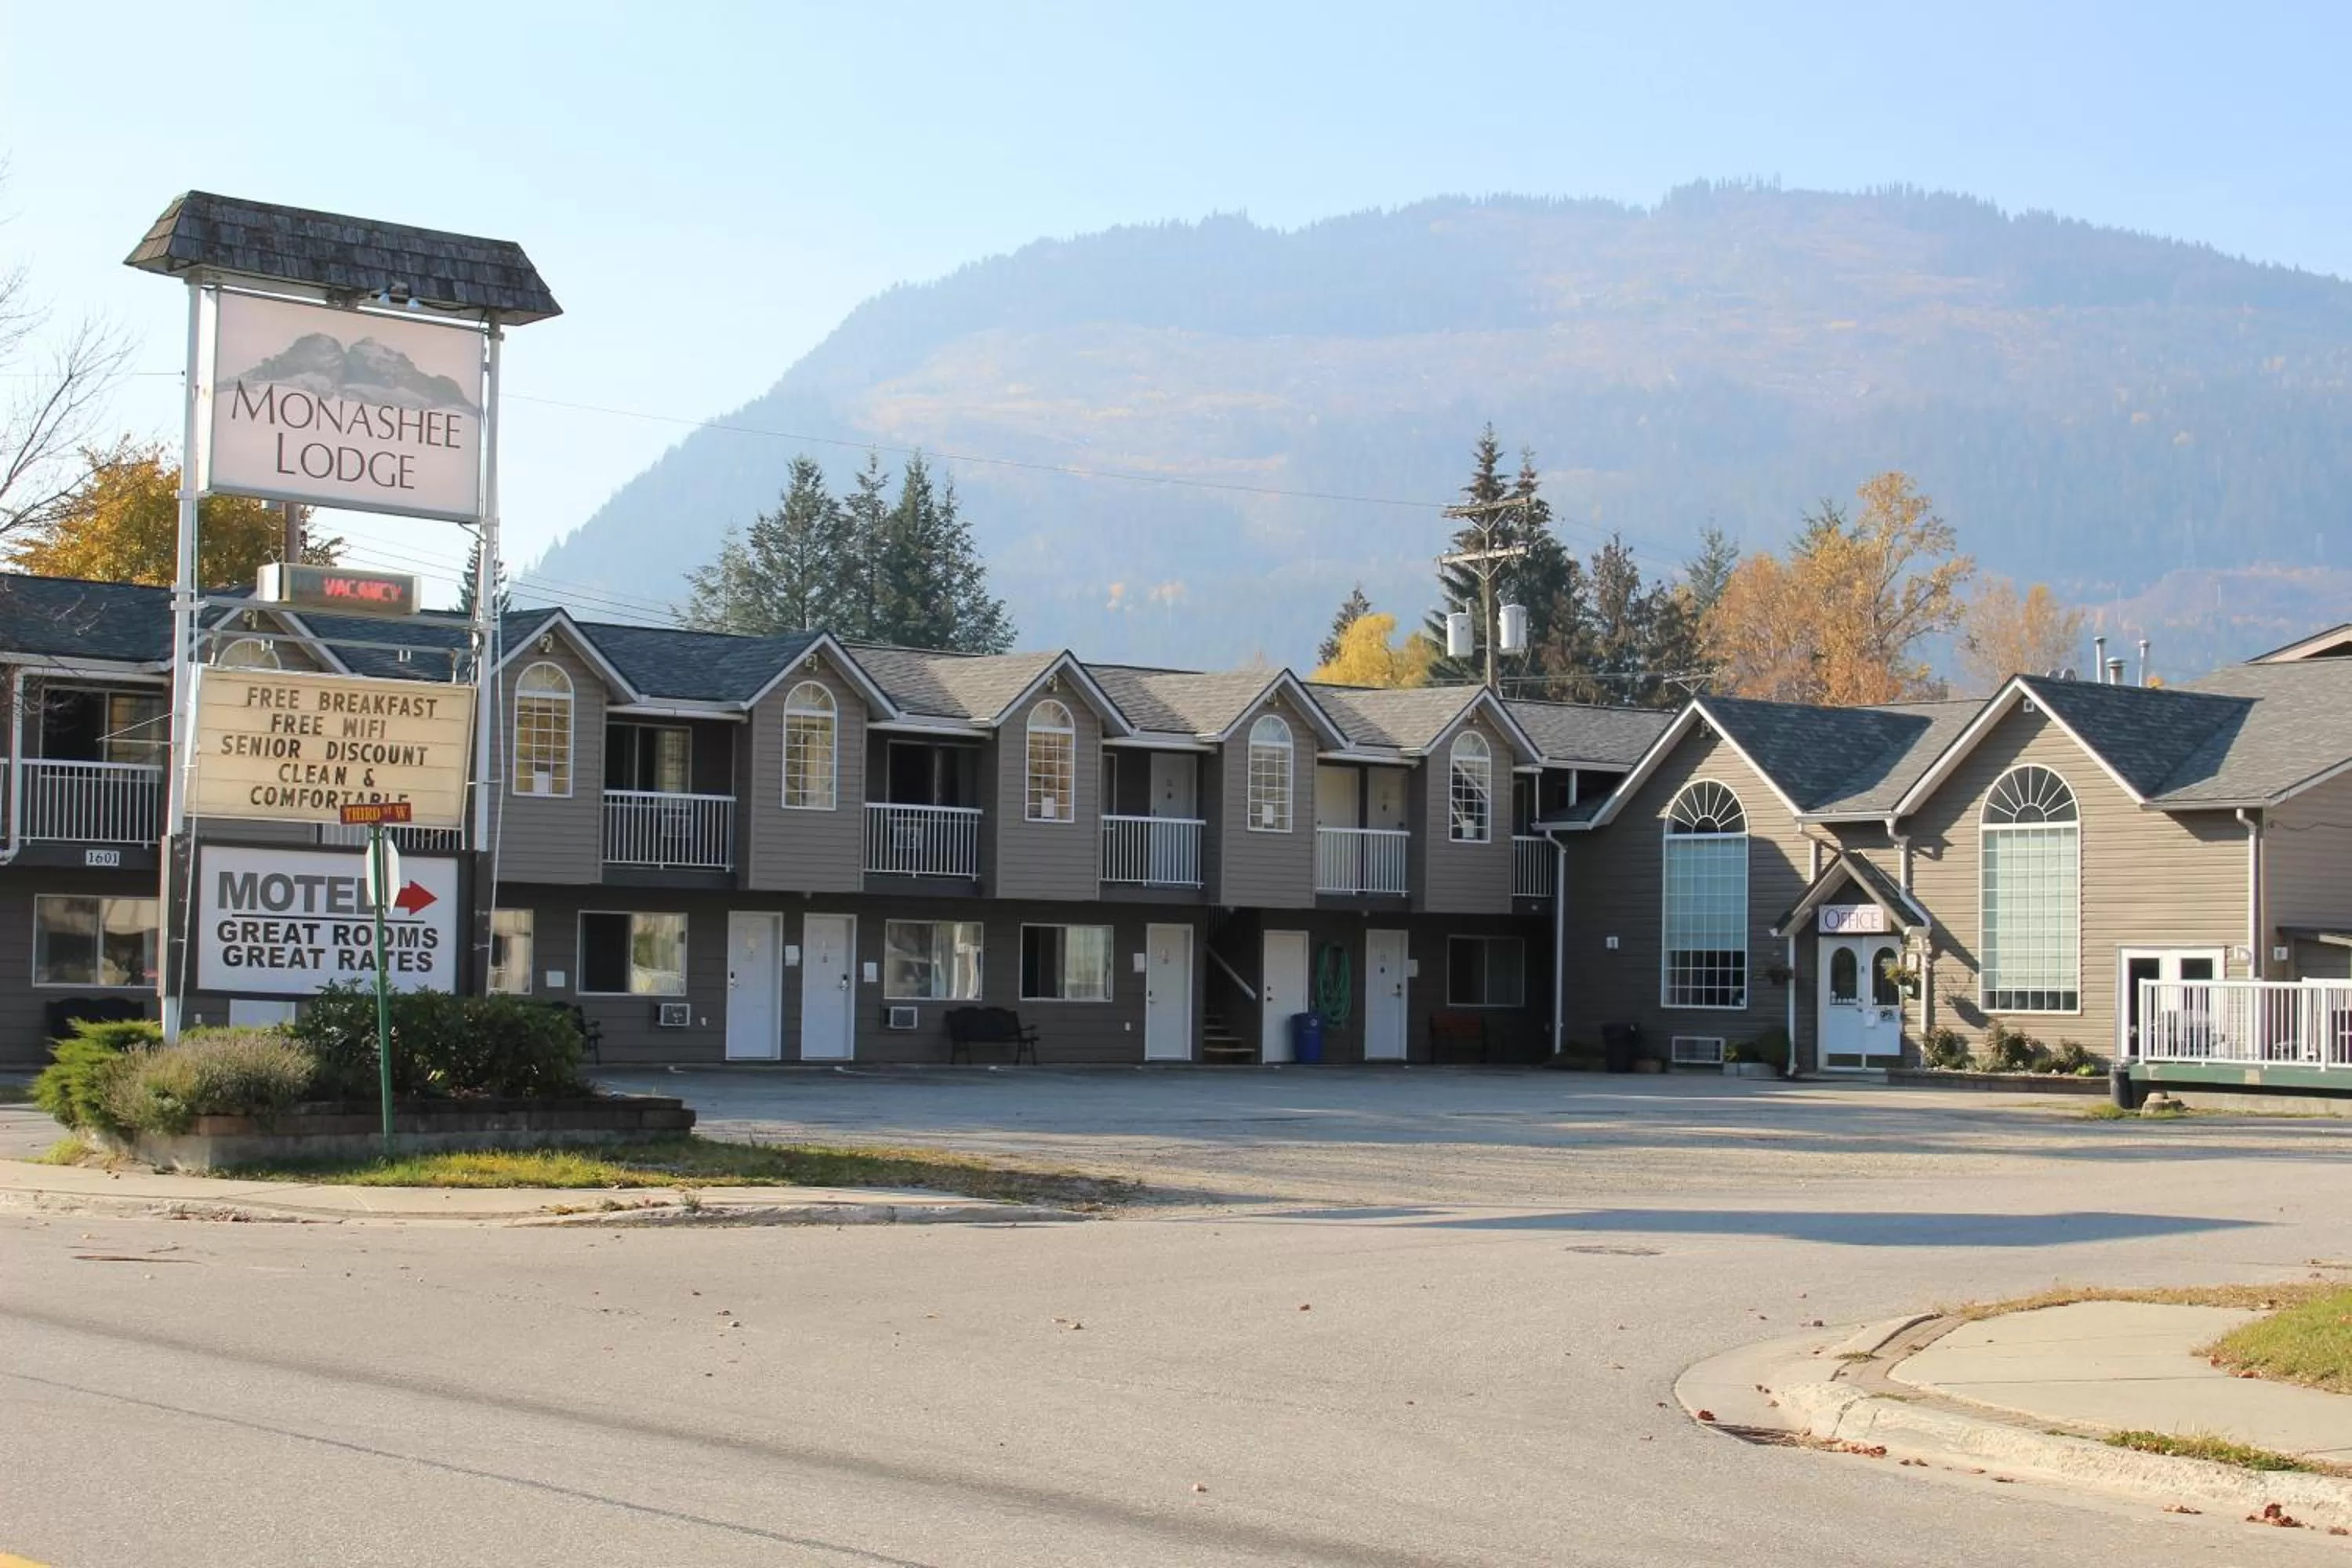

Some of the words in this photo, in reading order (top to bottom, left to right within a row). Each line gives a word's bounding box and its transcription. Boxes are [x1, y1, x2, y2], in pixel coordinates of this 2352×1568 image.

[231, 380, 462, 449] MONASHEE
[277, 432, 415, 490] LODGE
[323, 577, 402, 602] VACANCY
[247, 687, 300, 710] FREE
[319, 691, 438, 718] BREAKFAST
[270, 713, 323, 735] FREE
[343, 718, 387, 739] WIFI
[220, 735, 301, 758] SENIOR
[325, 741, 429, 766] DISCOUNT
[278, 763, 347, 785] CLEAN
[363, 768, 375, 787] &
[344, 806, 380, 822] THIRD
[396, 805, 408, 819] W
[89, 852, 118, 864] 1601
[217, 871, 376, 915] MOTEL
[217, 920, 321, 945] GREAT
[1824, 909, 1879, 930] OFFICE
[222, 946, 325, 969] GREAT
[338, 949, 433, 973] RATES
